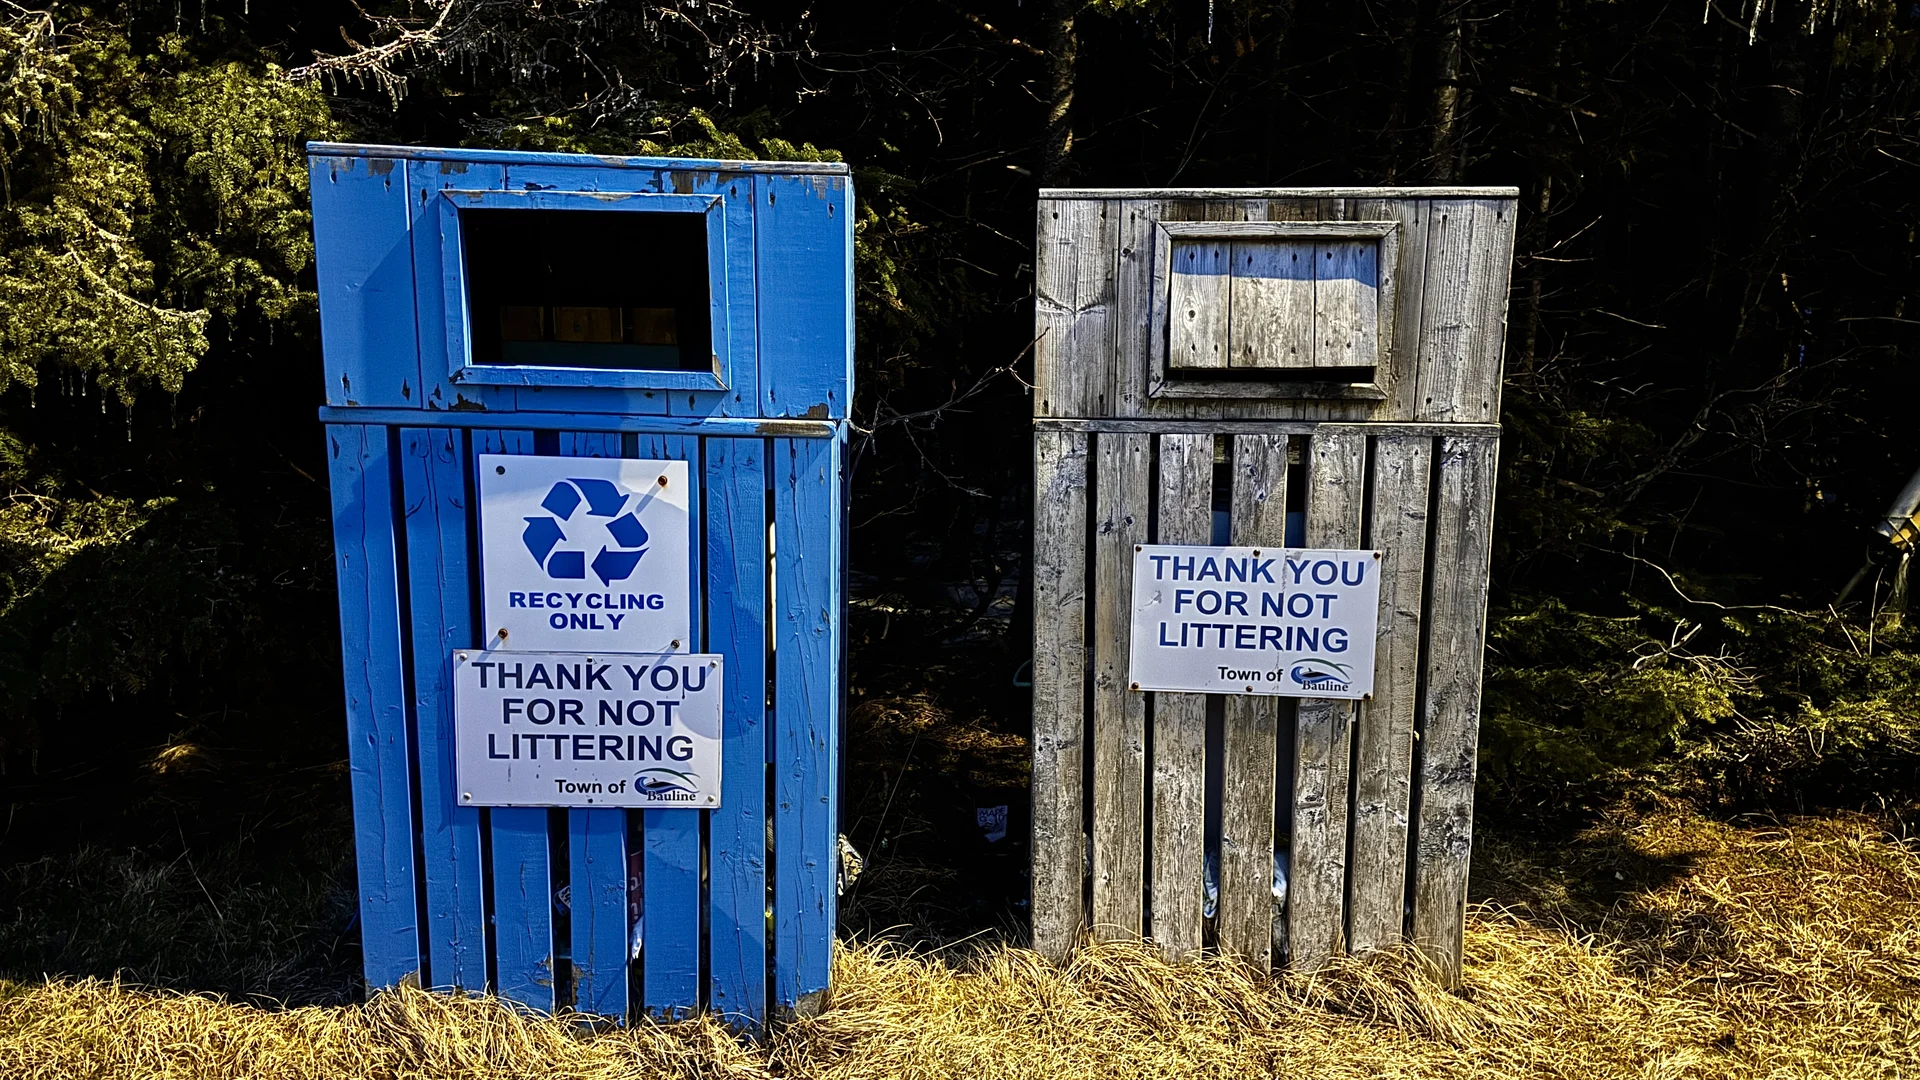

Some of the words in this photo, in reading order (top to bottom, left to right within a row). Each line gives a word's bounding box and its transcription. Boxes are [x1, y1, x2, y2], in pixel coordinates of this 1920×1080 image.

[1149, 556, 1276, 584] THANK
[1286, 559, 1365, 586] YOU
[509, 591, 664, 610] RECYCLING
[1174, 589, 1249, 616] FOR
[1261, 592, 1338, 619] NOT
[549, 612, 626, 630] ONLY
[1159, 622, 1348, 653] LITTERING
[471, 662, 613, 691] THANK
[622, 664, 706, 692] YOU
[1218, 666, 1261, 682] Town
[1266, 668, 1284, 682] of
[1301, 680, 1350, 692] Bauline
[502, 698, 586, 726] FOR
[598, 699, 680, 727] NOT
[488, 733, 693, 762] LITTERING
[554, 779, 603, 794] Town
[607, 779, 627, 794] of
[646, 789, 697, 802] Bauline
